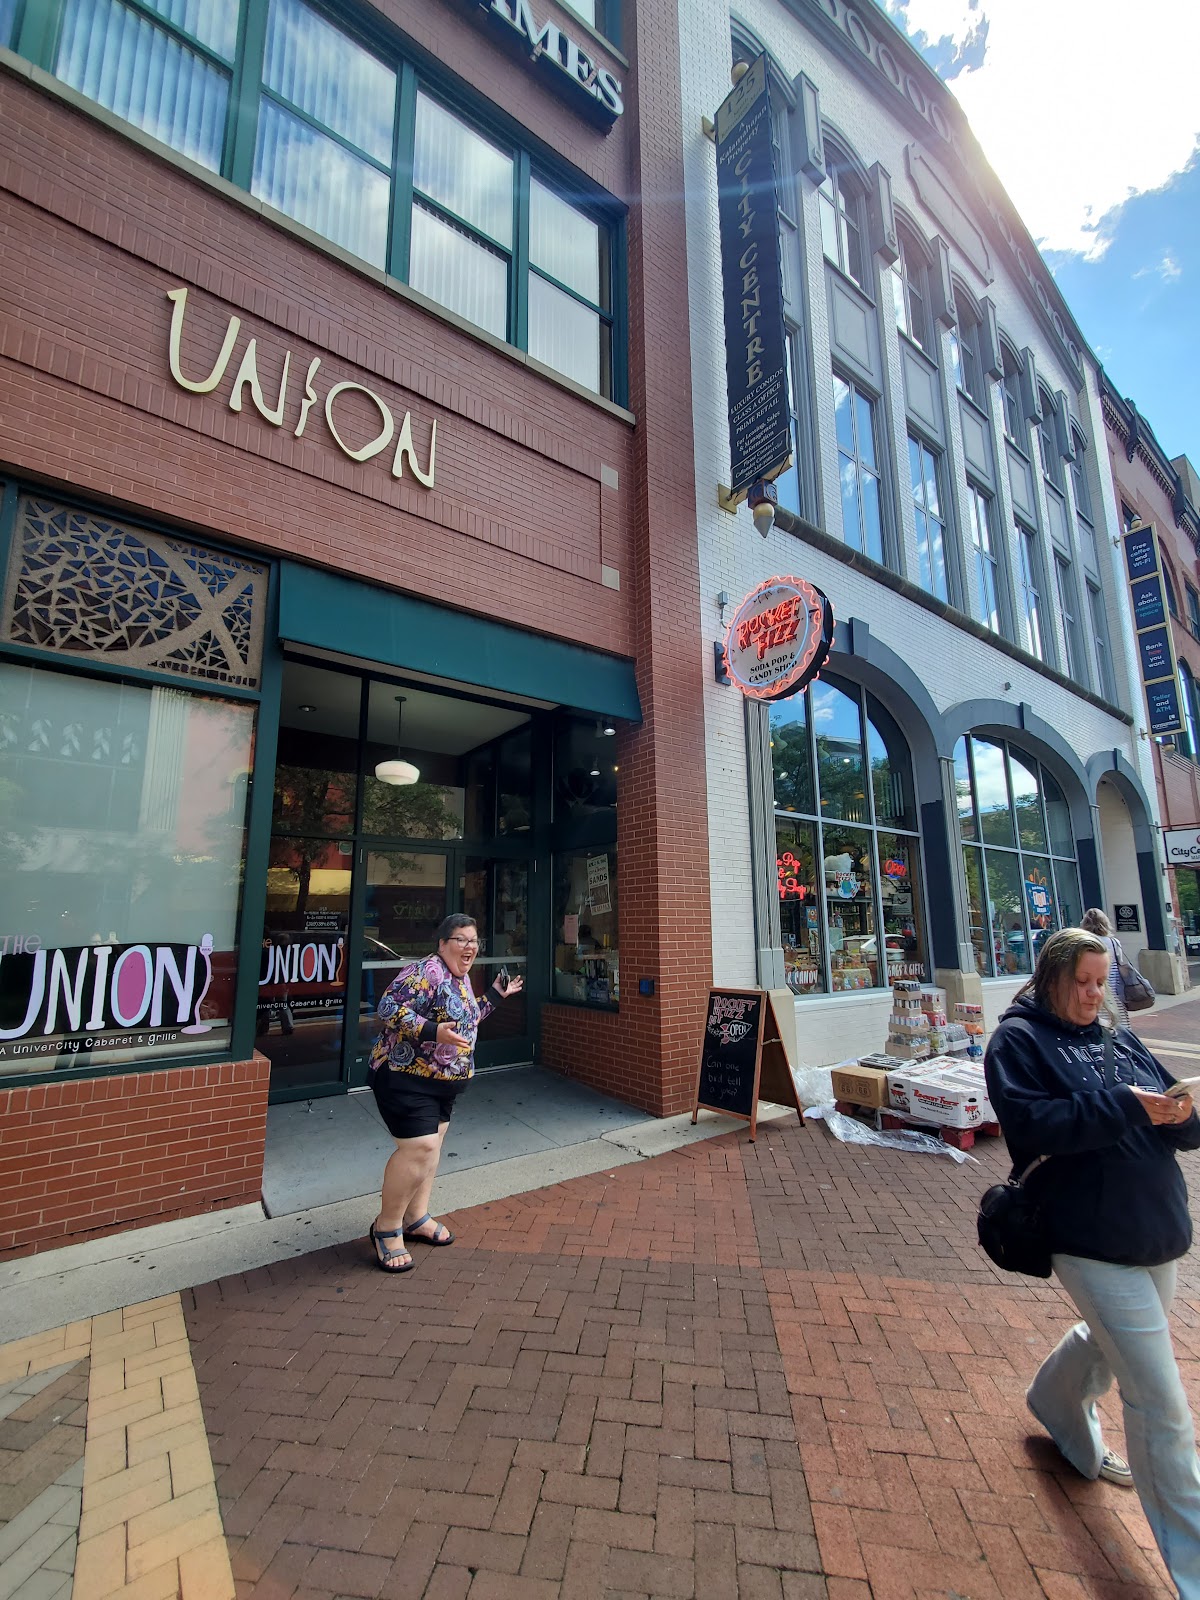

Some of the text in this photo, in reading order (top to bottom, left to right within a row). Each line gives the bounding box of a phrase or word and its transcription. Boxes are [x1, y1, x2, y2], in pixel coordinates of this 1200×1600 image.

[727, 71, 755, 116] 125
[734, 149, 756, 239] CITY
[739, 242, 765, 389] CENTRE
[167, 288, 437, 488] UNION
[730, 367, 784, 415] LUXURY CONDOS
[732, 381, 782, 424] CLASS A OFFICE
[736, 397, 780, 435] PRIME RETAIL
[766, 412, 781, 425] Sales
[744, 420, 778, 448] Management
[1130, 547, 1151, 558] coffee
[1132, 542, 1147, 551] Free
[1134, 553, 1148, 562] and
[1135, 601, 1162, 613] meeting
[1137, 596, 1158, 606] about
[1139, 608, 1159, 618] space
[737, 595, 802, 652] ROCKET
[752, 618, 801, 661] FIZZ
[1145, 642, 1163, 651] Bank
[749, 651, 796, 674] SODA POP &
[1149, 655, 1162, 663] you
[748, 660, 798, 683] CANDY SHOP
[1151, 693, 1171, 701] Teller
[1155, 699, 1170, 707] and
[1155, 705, 1171, 713] ATM
[589, 873, 608, 885] SANDS
[794, 969, 818, 985] CANDY
[888, 964, 902, 977] GAGS
[289, 1000, 317, 1008] Cabaret
[729, 1023, 747, 1037] OPEN
[85, 1036, 133, 1048] Cabaret
[706, 1055, 740, 1072] Can one
[727, 1075, 741, 1087] tell
[858, 1085, 868, 1095] 66
